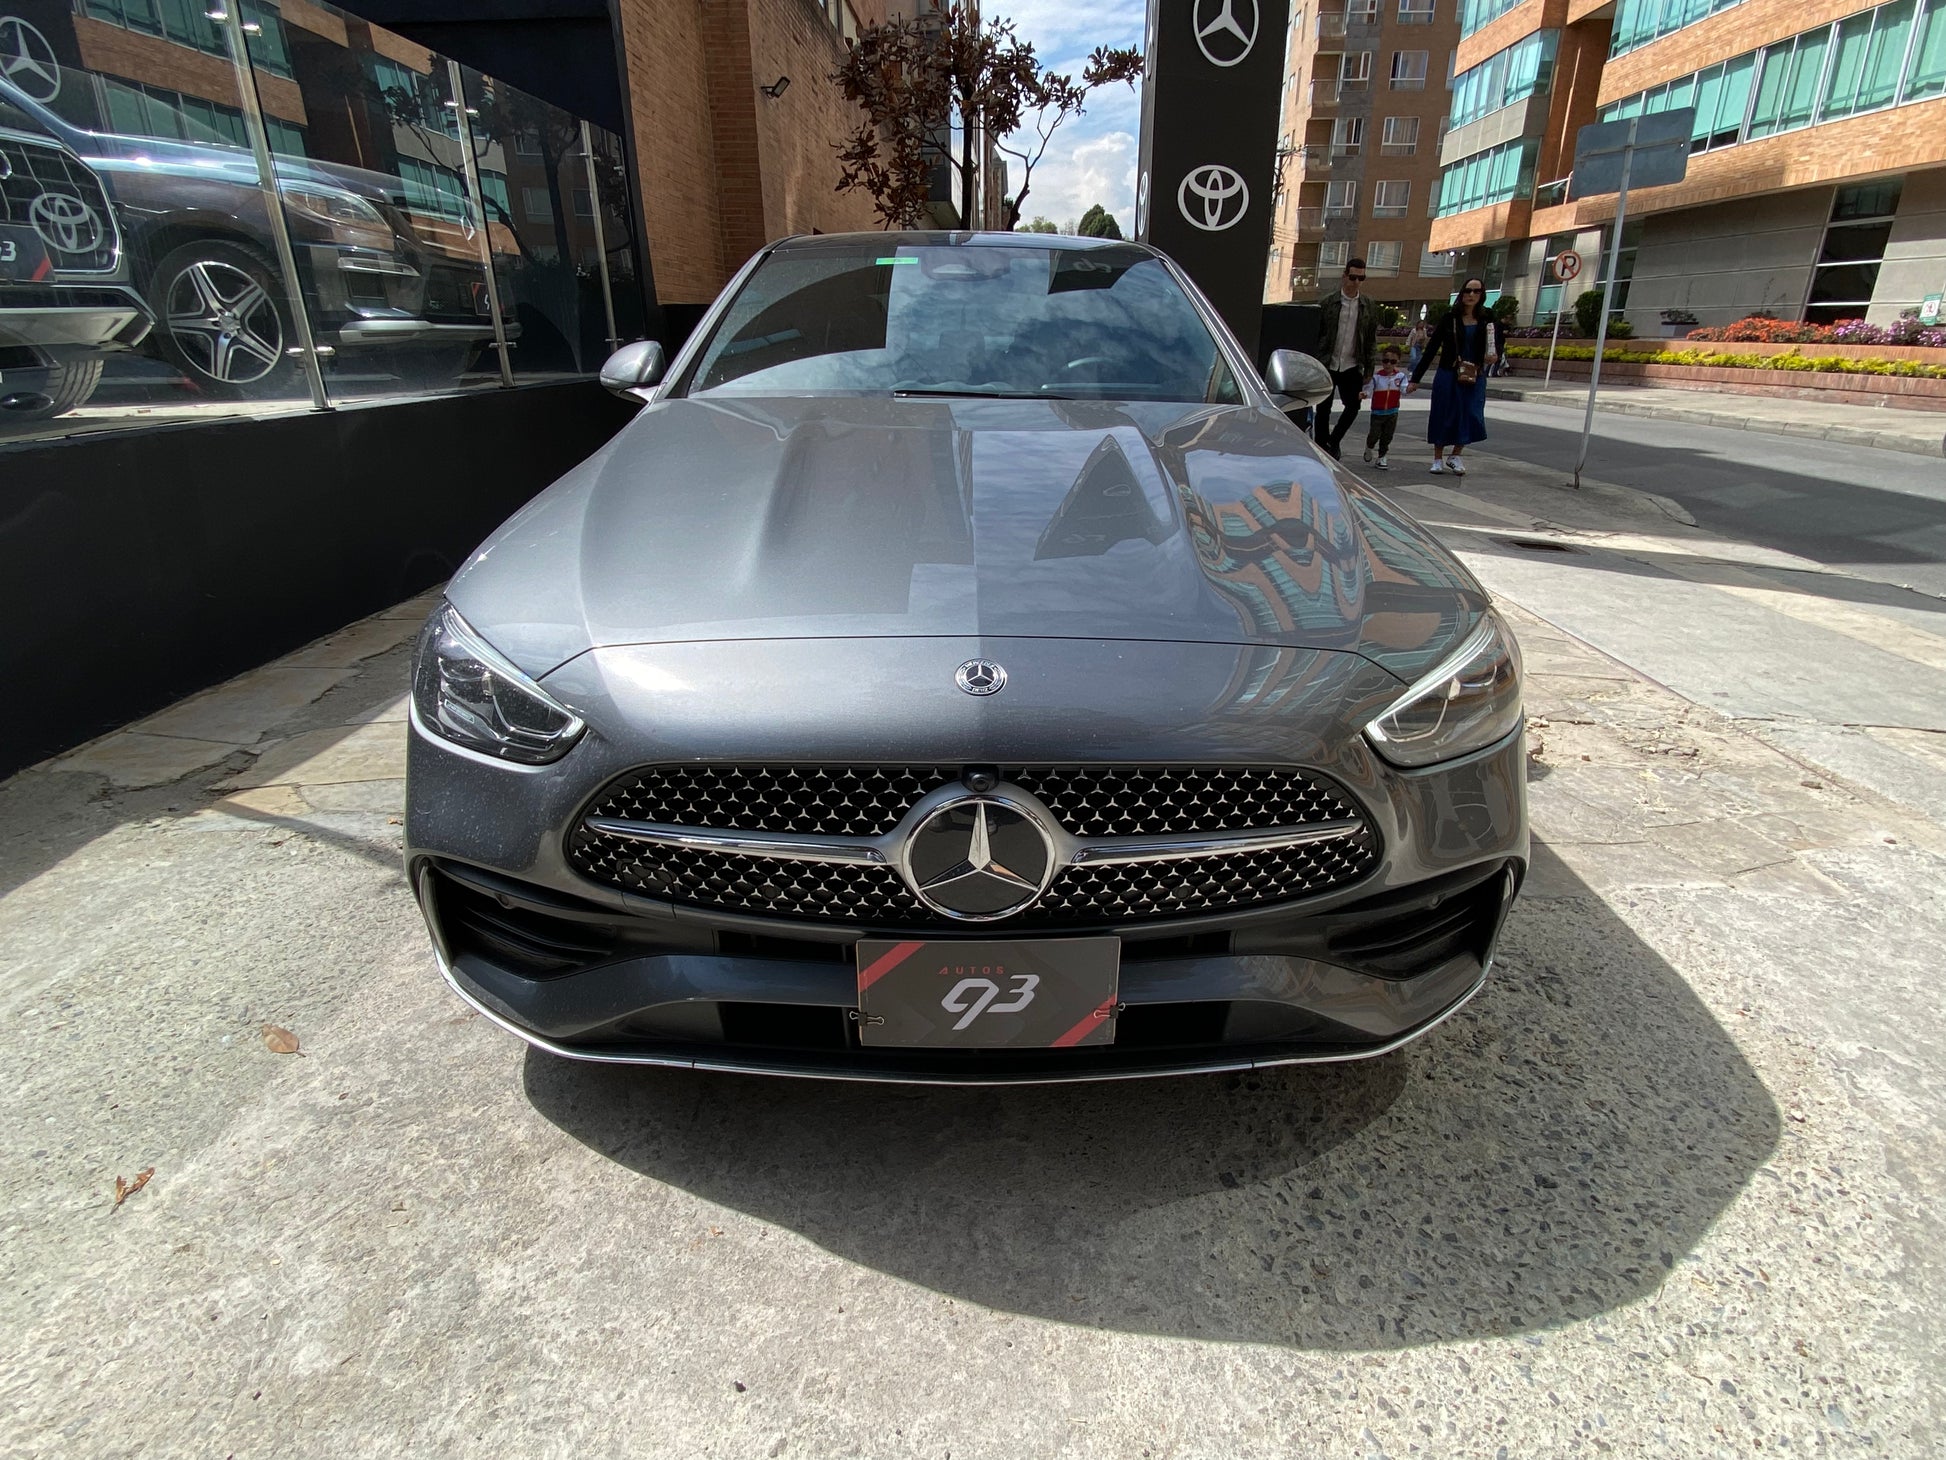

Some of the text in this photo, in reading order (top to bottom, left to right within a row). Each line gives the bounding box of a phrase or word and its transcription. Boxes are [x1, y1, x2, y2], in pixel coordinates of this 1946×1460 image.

[1561, 255, 1577, 277] P
[938, 966, 1005, 975] AUTOS
[941, 974, 1040, 1031] 93
